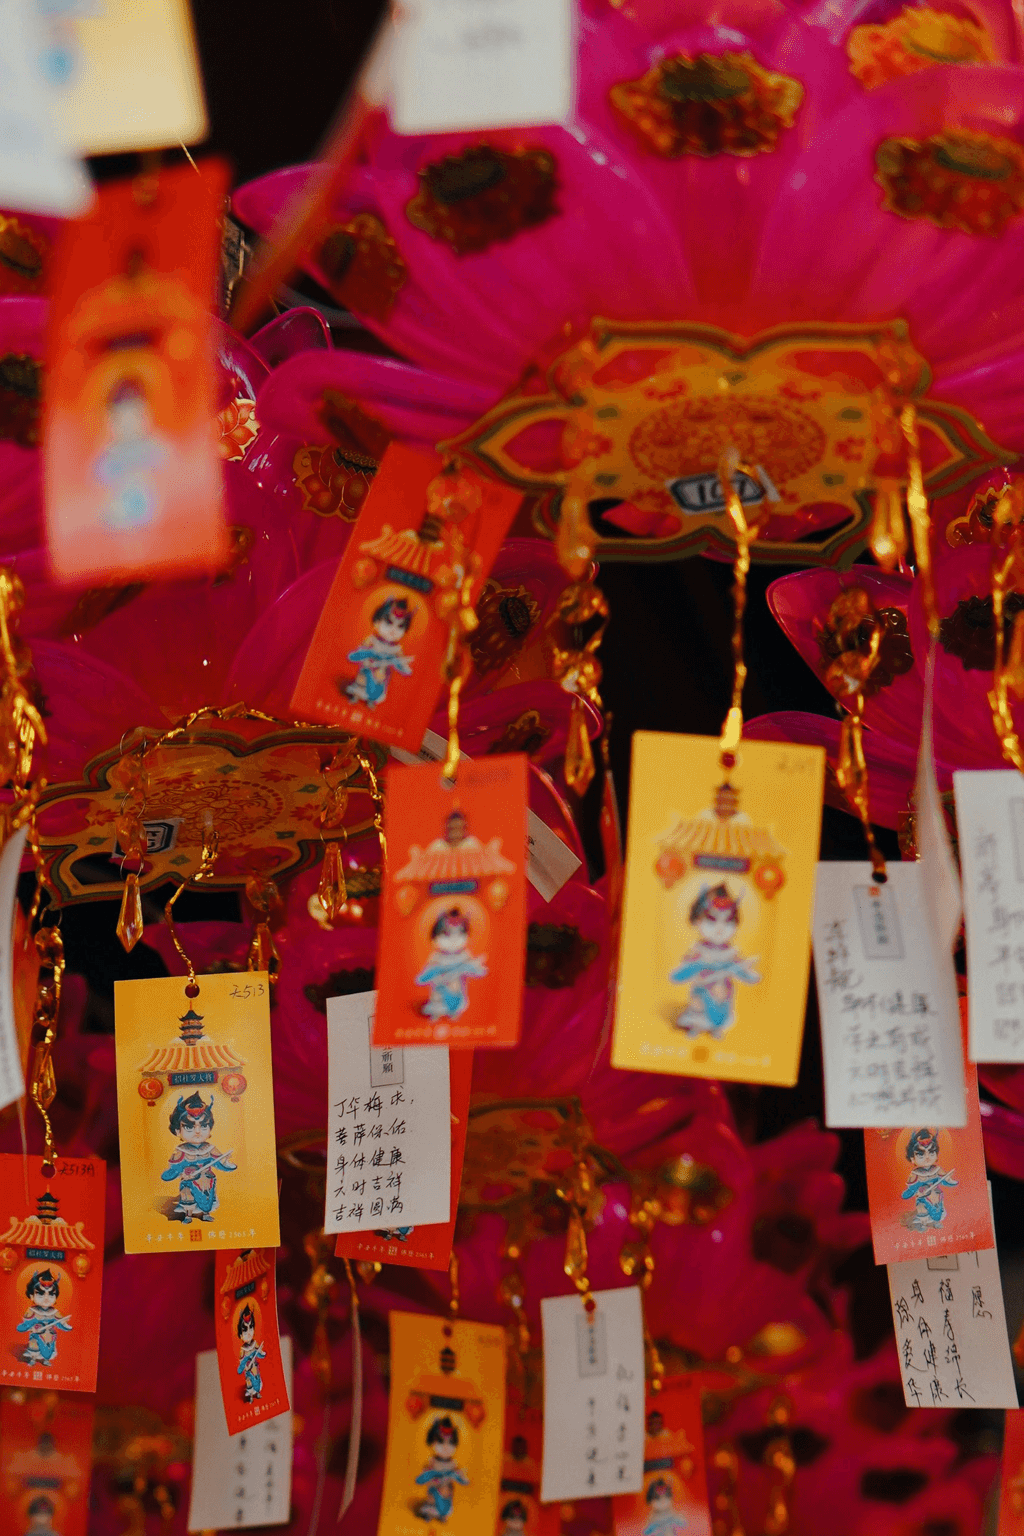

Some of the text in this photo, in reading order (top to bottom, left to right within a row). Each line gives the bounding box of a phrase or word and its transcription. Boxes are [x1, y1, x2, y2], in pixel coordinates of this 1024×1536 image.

[380, 1044, 394, 1075] 祈願
[334, 1117, 407, 1147] 菩萨保佑
[333, 1146, 407, 1176] 身体健康
[333, 1170, 404, 1198] 六时吉祥
[332, 1196, 405, 1224] 吉祥圆满
